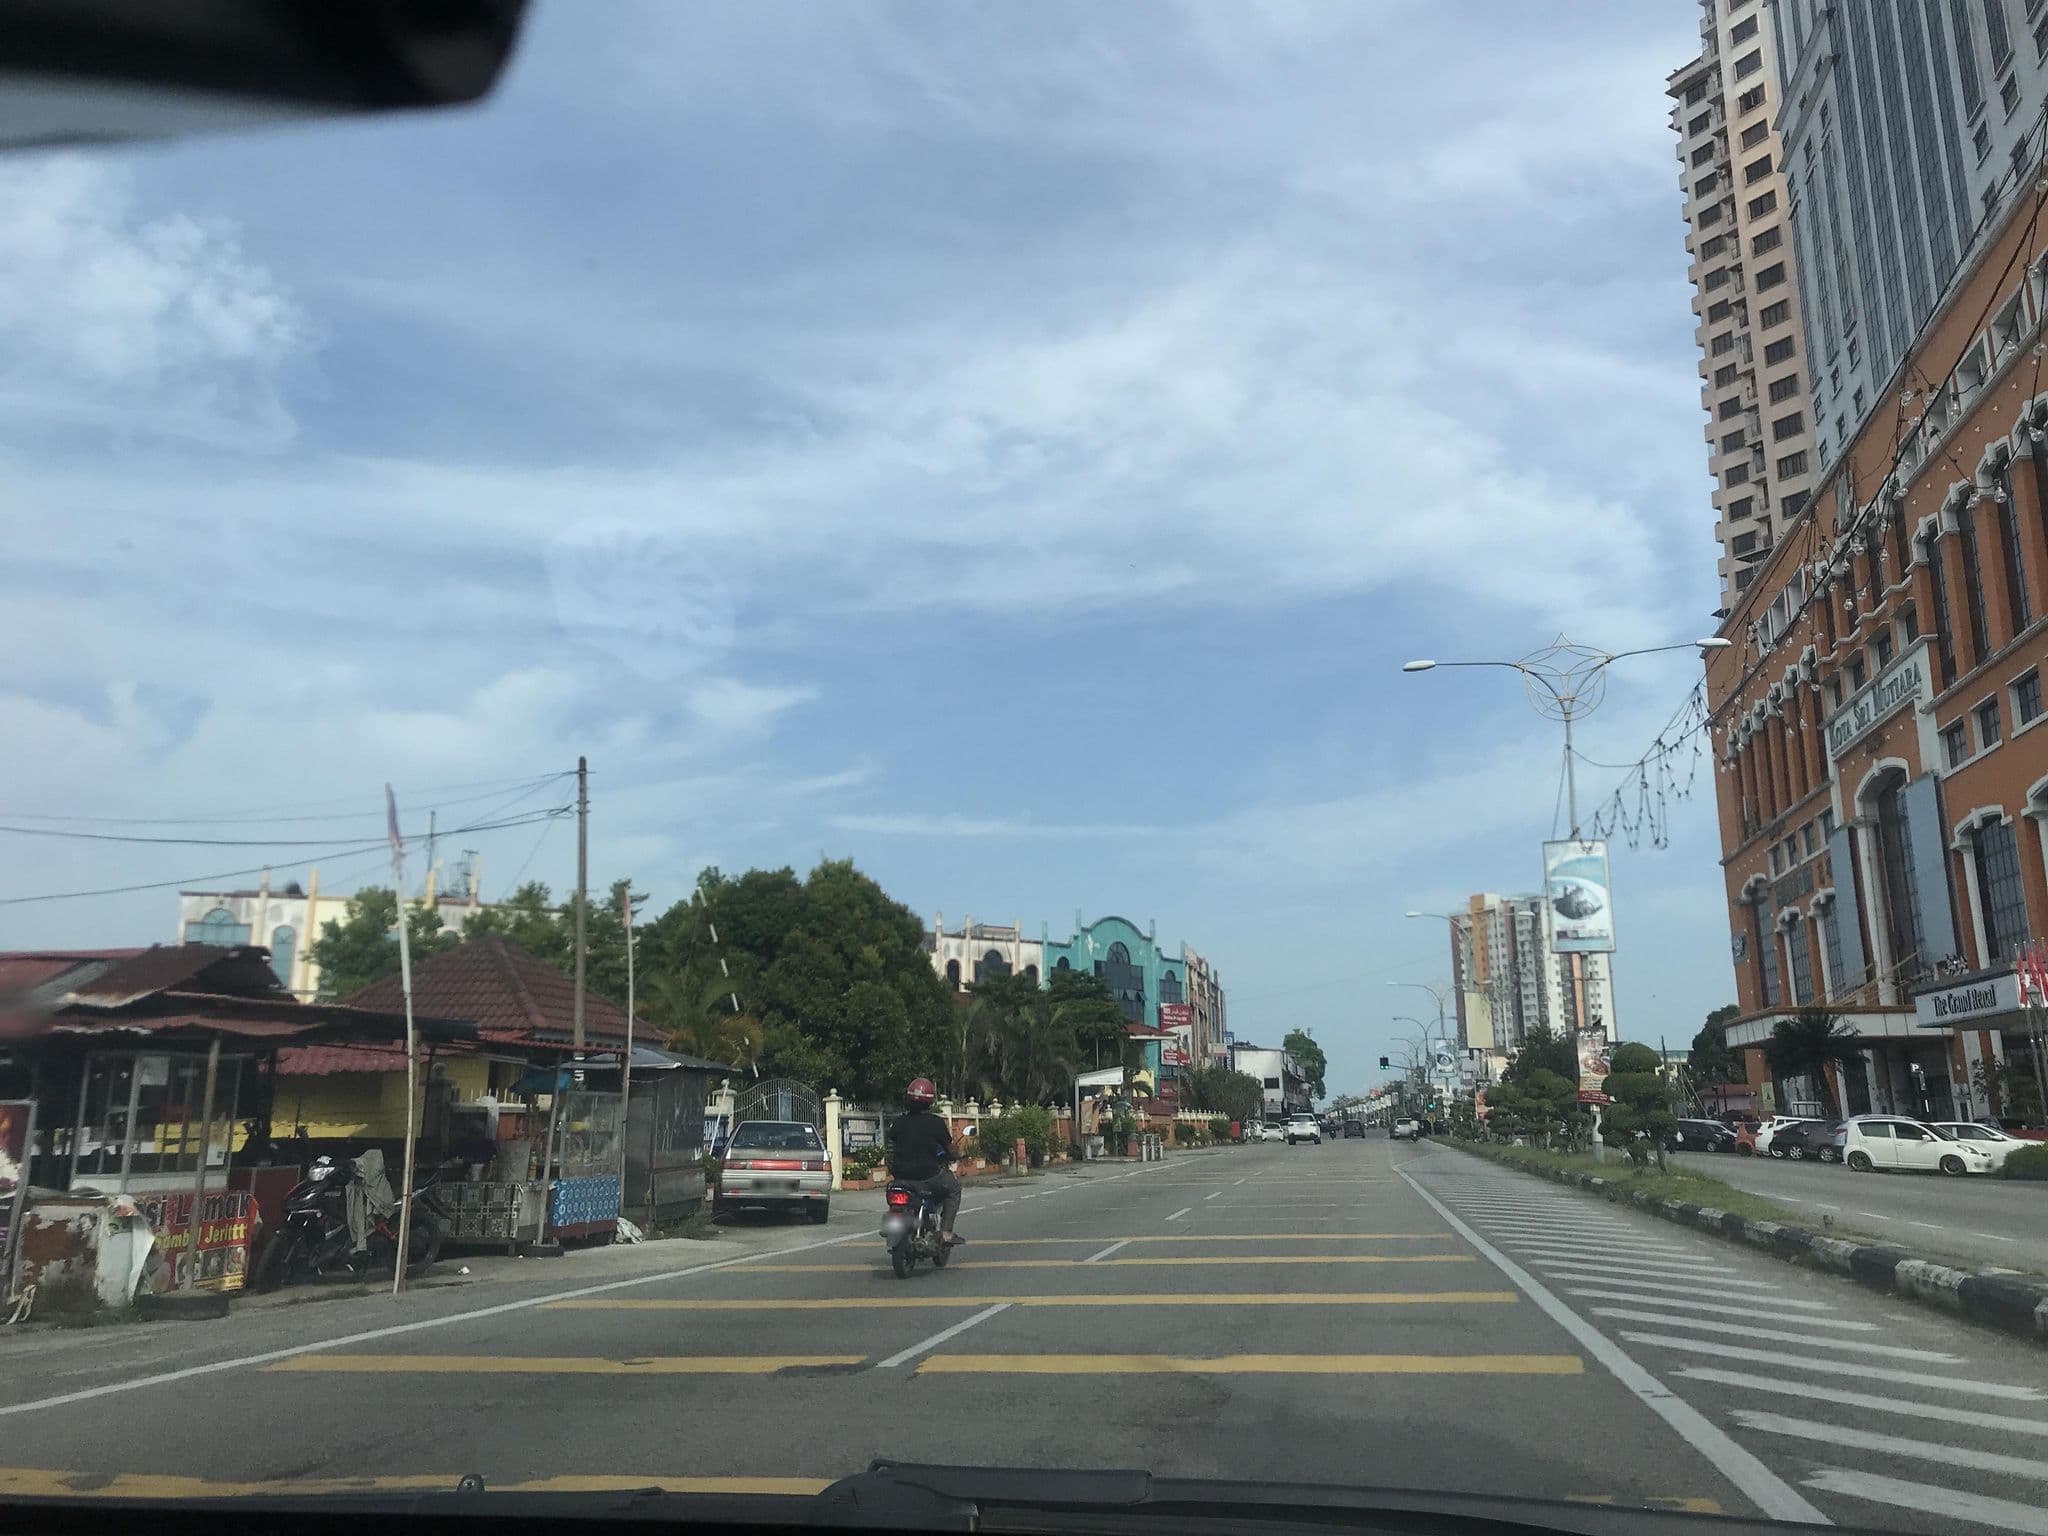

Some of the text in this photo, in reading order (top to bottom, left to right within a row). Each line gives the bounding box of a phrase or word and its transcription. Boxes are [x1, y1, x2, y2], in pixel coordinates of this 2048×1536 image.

[1853, 703, 1871, 731] SRI
[1933, 995, 1948, 1017] The
[1948, 989, 1972, 1013] Grand
[175, 1192, 254, 1225] Lmak
[154, 1228, 202, 1248] Sambl
